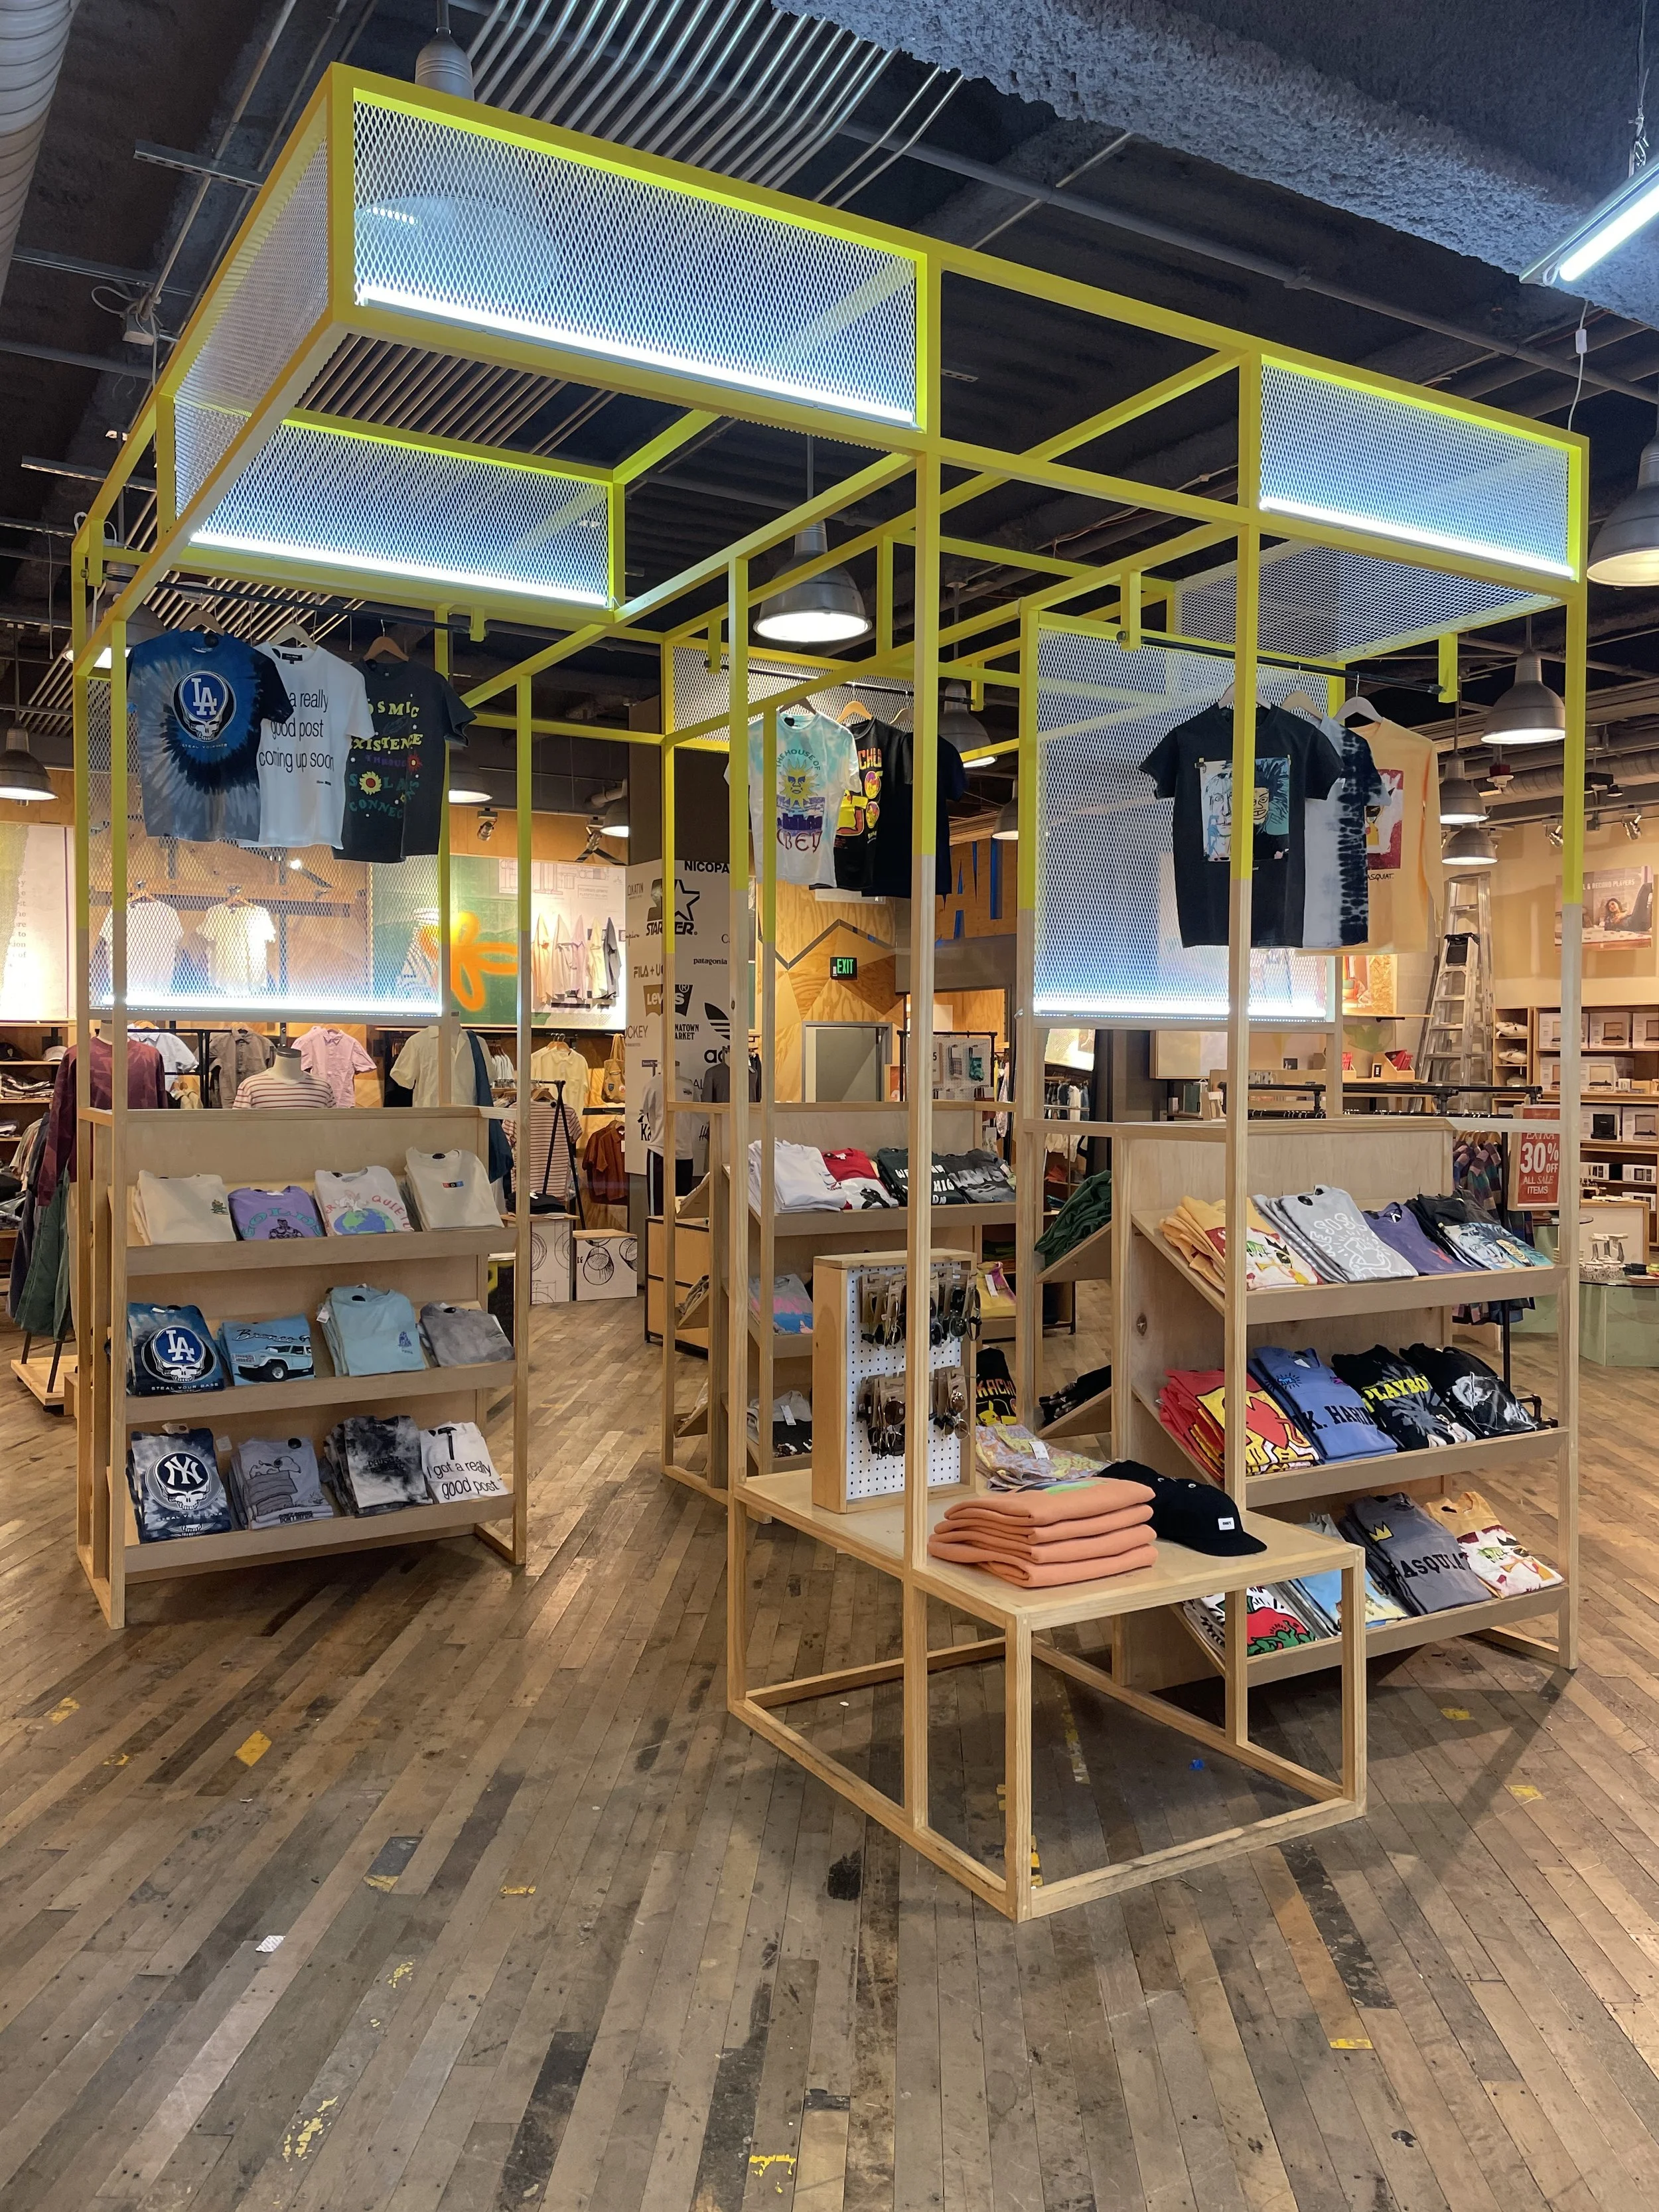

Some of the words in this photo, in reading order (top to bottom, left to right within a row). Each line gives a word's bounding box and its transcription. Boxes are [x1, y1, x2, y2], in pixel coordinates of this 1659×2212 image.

[191, 678, 217, 715] LA
[289, 692, 297, 707] a
[300, 689, 328, 713] really
[367, 700, 419, 717] OSMIC
[271, 717, 296, 740] good
[299, 719, 324, 741] post
[353, 733, 423, 751] XISTENCE
[259, 747, 293, 773] coming
[296, 753, 307, 773] up
[310, 753, 334, 772] soon
[784, 749, 816, 761] HOUSE
[813, 759, 821, 771] OF
[684, 860, 730, 873] NICOPA
[1613, 879, 1635, 887] PLAYERS
[646, 921, 694, 936] STARER
[634, 965, 648, 978] FILA
[837, 958, 853, 974] EXIT
[675, 1023, 699, 1032] NATOWN
[1546, 1163, 1559, 1173] OFF
[1523, 1176, 1536, 1185] ALL
[1537, 1175, 1554, 1184] SALE
[1528, 1186, 1548, 1195] ITEMS
[232, 1329, 298, 1343] Bronco
[166, 1329, 195, 1362] LA
[164, 1455, 203, 1486] NY
[427, 1466, 432, 1479] I
[433, 1461, 455, 1479] got
[455, 1462, 465, 1472] a
[465, 1460, 492, 1477] really
[442, 1476, 472, 1500] good
[473, 1479, 500, 1495] post
